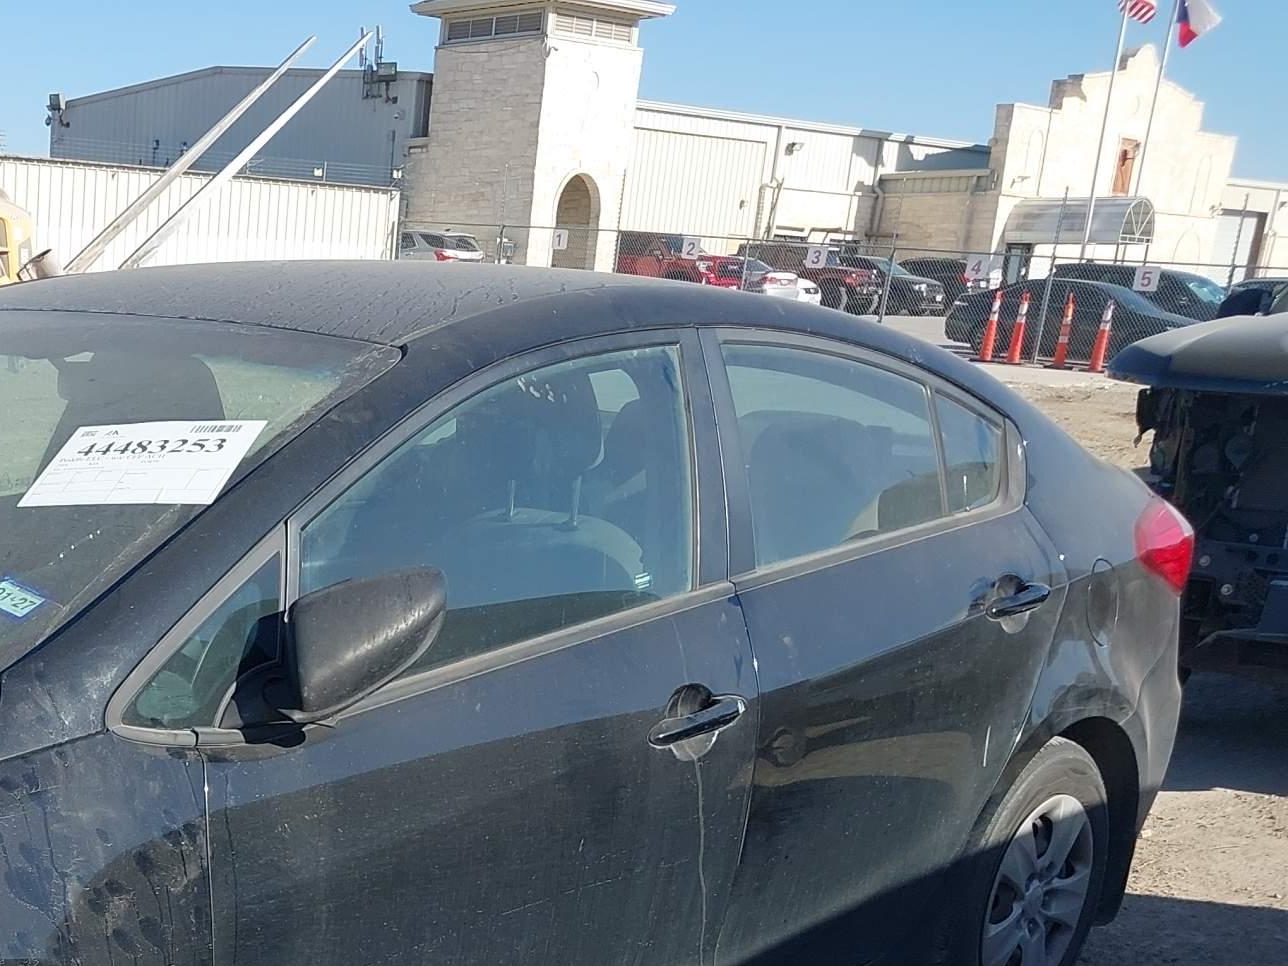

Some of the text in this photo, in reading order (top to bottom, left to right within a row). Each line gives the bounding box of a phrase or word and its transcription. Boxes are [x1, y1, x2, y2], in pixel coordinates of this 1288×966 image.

[555, 234, 562, 246] 1
[686, 242, 696, 256] 2
[812, 251, 822, 264] 3
[971, 260, 982, 275] 4
[1141, 271, 1153, 287] 5
[77, 438, 227, 457] 44483253
